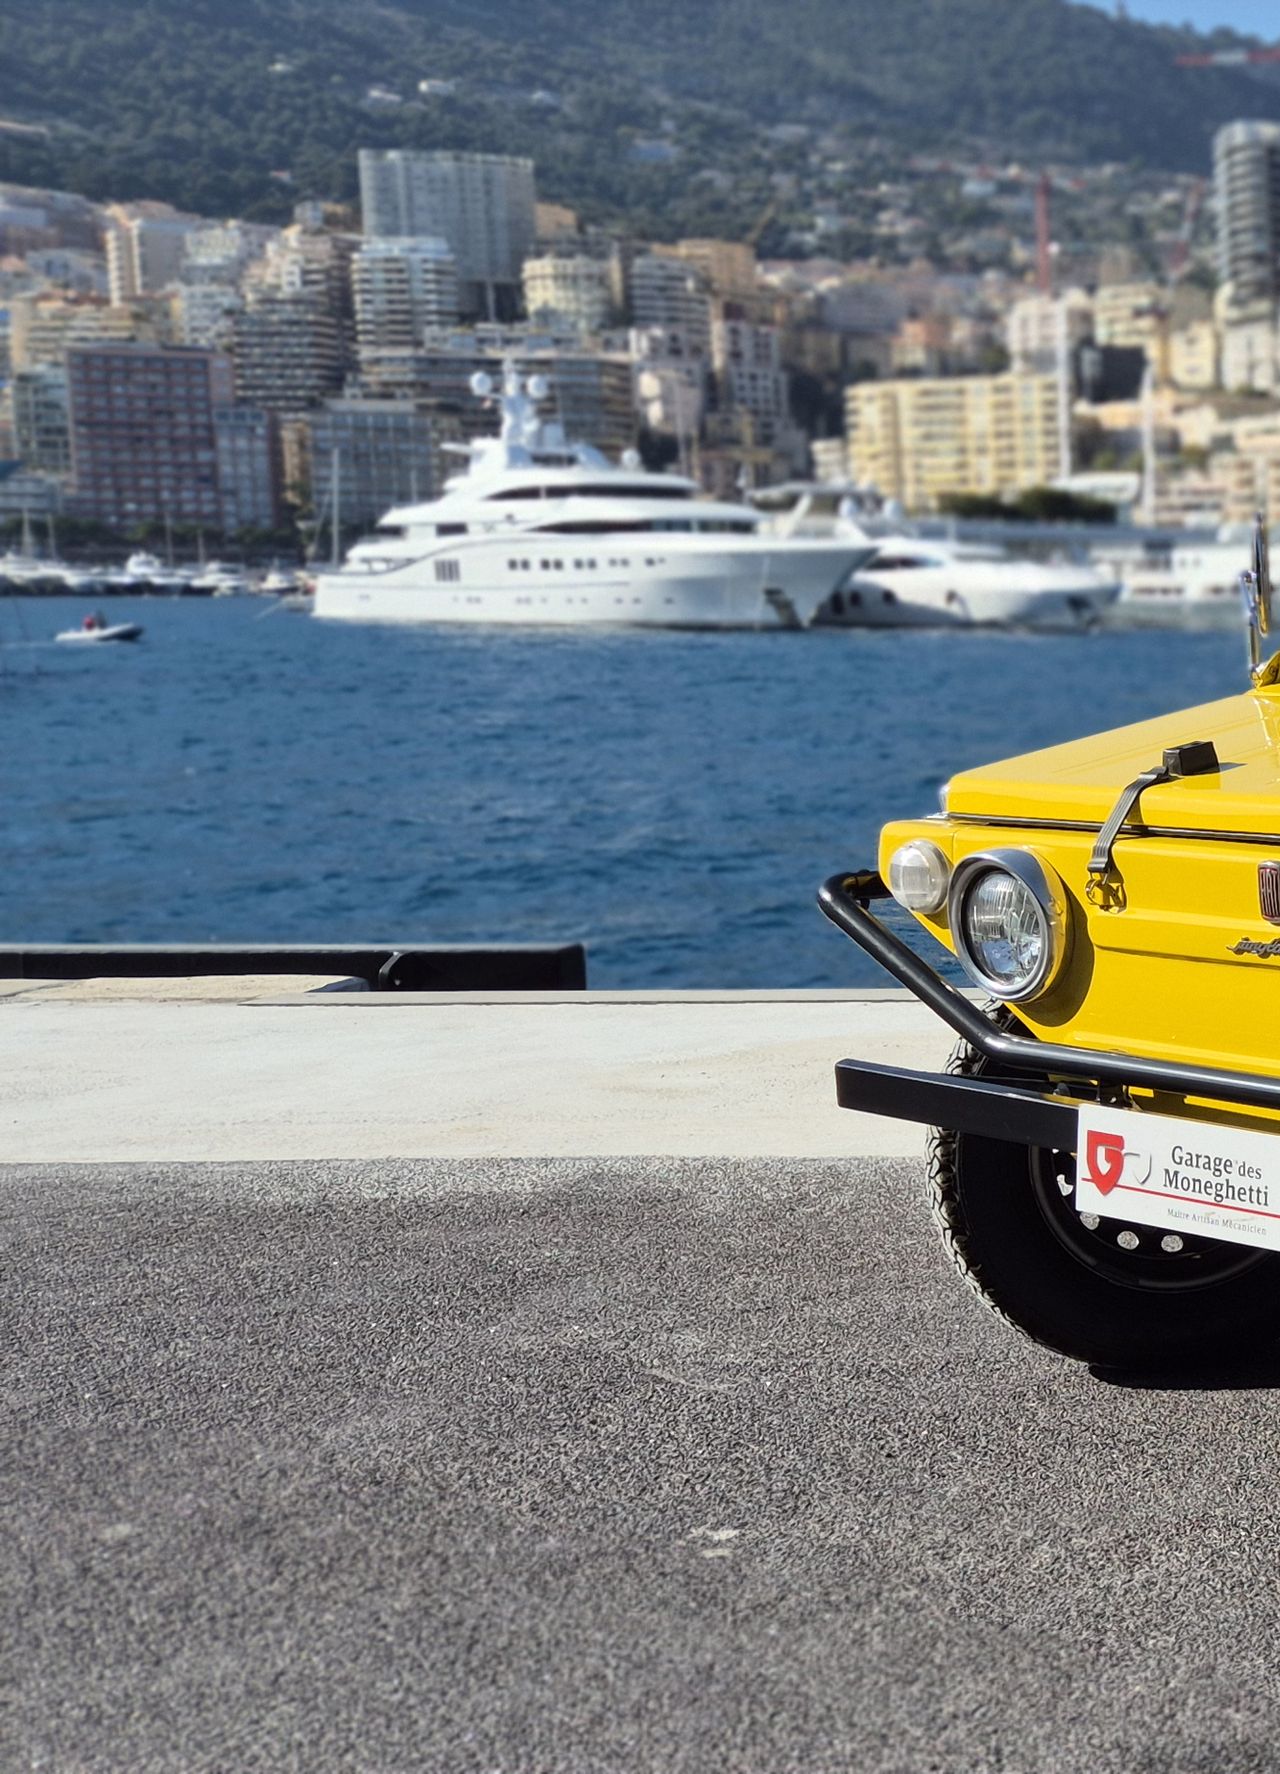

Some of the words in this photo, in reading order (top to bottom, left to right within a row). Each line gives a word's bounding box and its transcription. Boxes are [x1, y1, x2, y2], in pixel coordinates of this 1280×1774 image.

[1259, 867, 1280, 918] FIAT
[1171, 1145, 1233, 1176] Garage
[1238, 1161, 1263, 1180] des
[1163, 1168, 1269, 1207] Moneghetti
